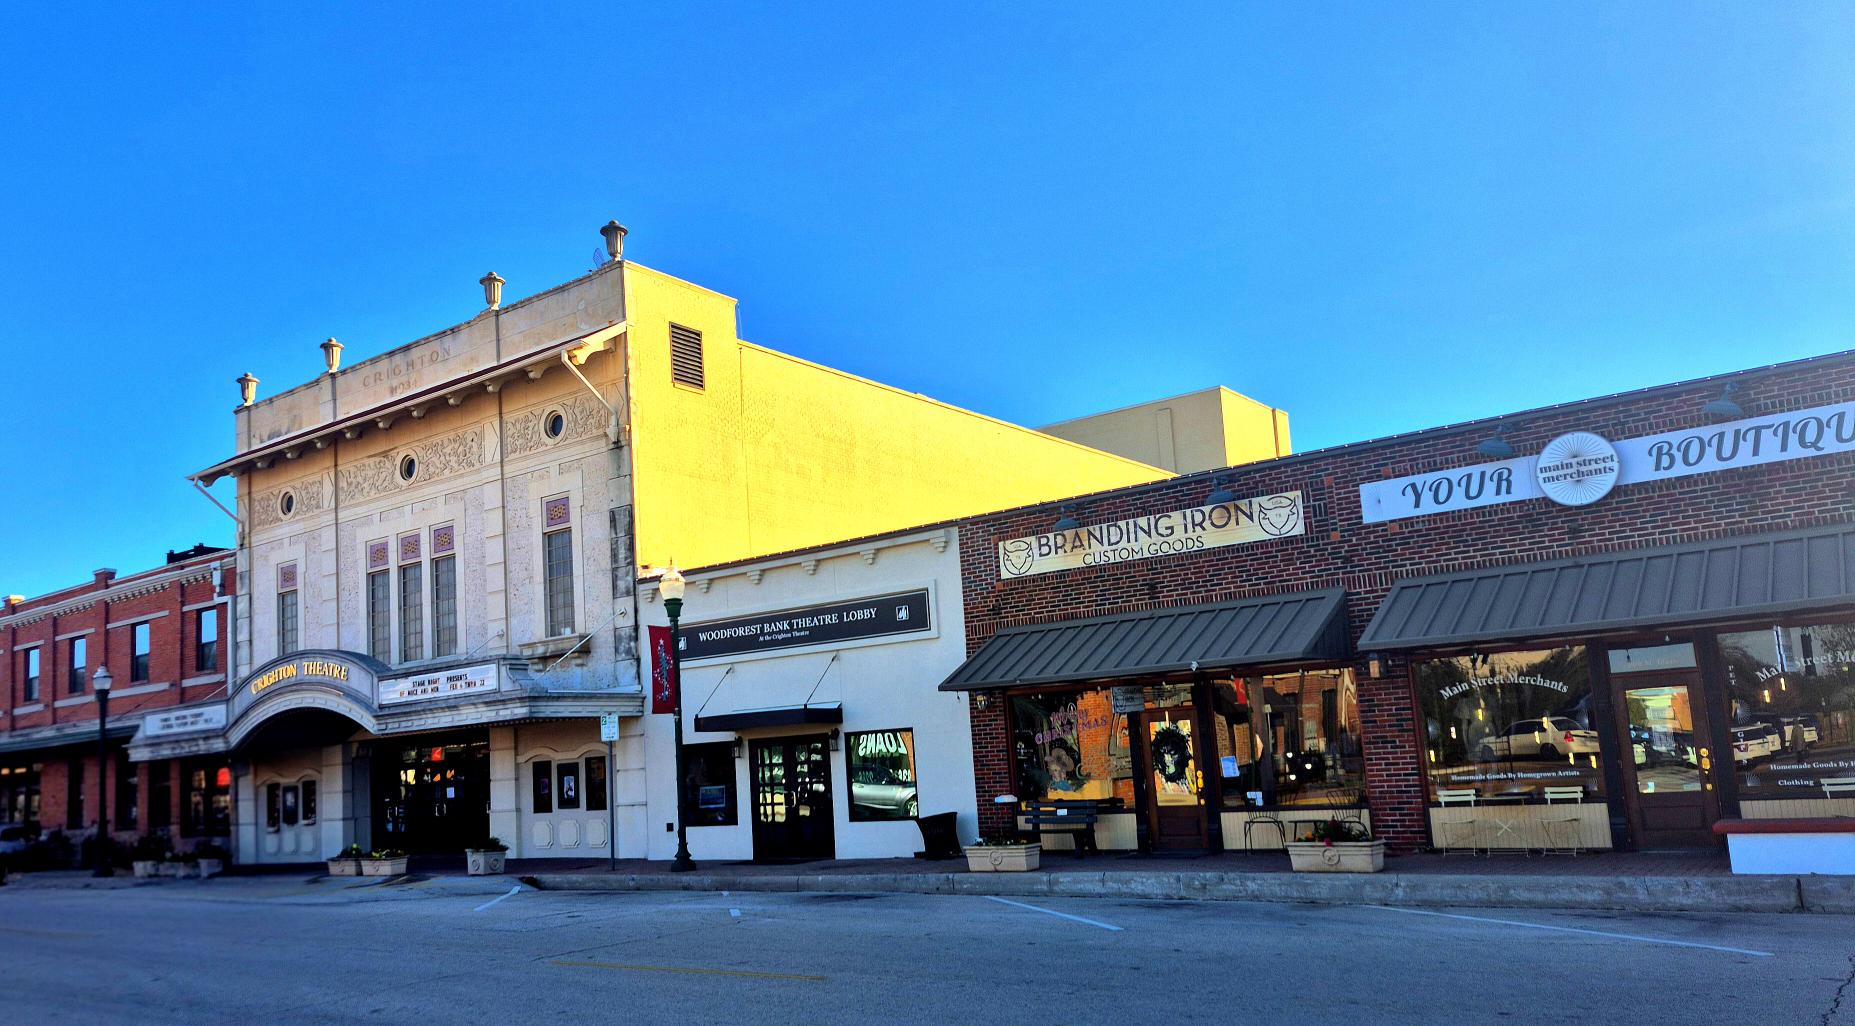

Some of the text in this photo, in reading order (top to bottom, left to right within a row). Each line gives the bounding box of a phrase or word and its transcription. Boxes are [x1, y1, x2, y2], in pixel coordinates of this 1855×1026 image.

[363, 345, 451, 387] CRIGHTON
[1540, 454, 1615, 474] main street
[1542, 466, 1615, 484] merchants
[1402, 467, 1513, 509] YOUR
[1037, 500, 1254, 557] BRANDING IRON
[1083, 535, 1204, 566] CUSTOM GOODS
[699, 608, 877, 642] WOODFOREST BANK THEATRE LOBBY
[251, 661, 349, 695] CRIGHTON THEATRE
[1440, 673, 1569, 700] Main Street Merchants
[1769, 761, 1811, 770] Homemade
[1812, 760, 1837, 769] Goods
[1839, 760, 1849, 768] By
[1778, 779, 1815, 787] Clothing
